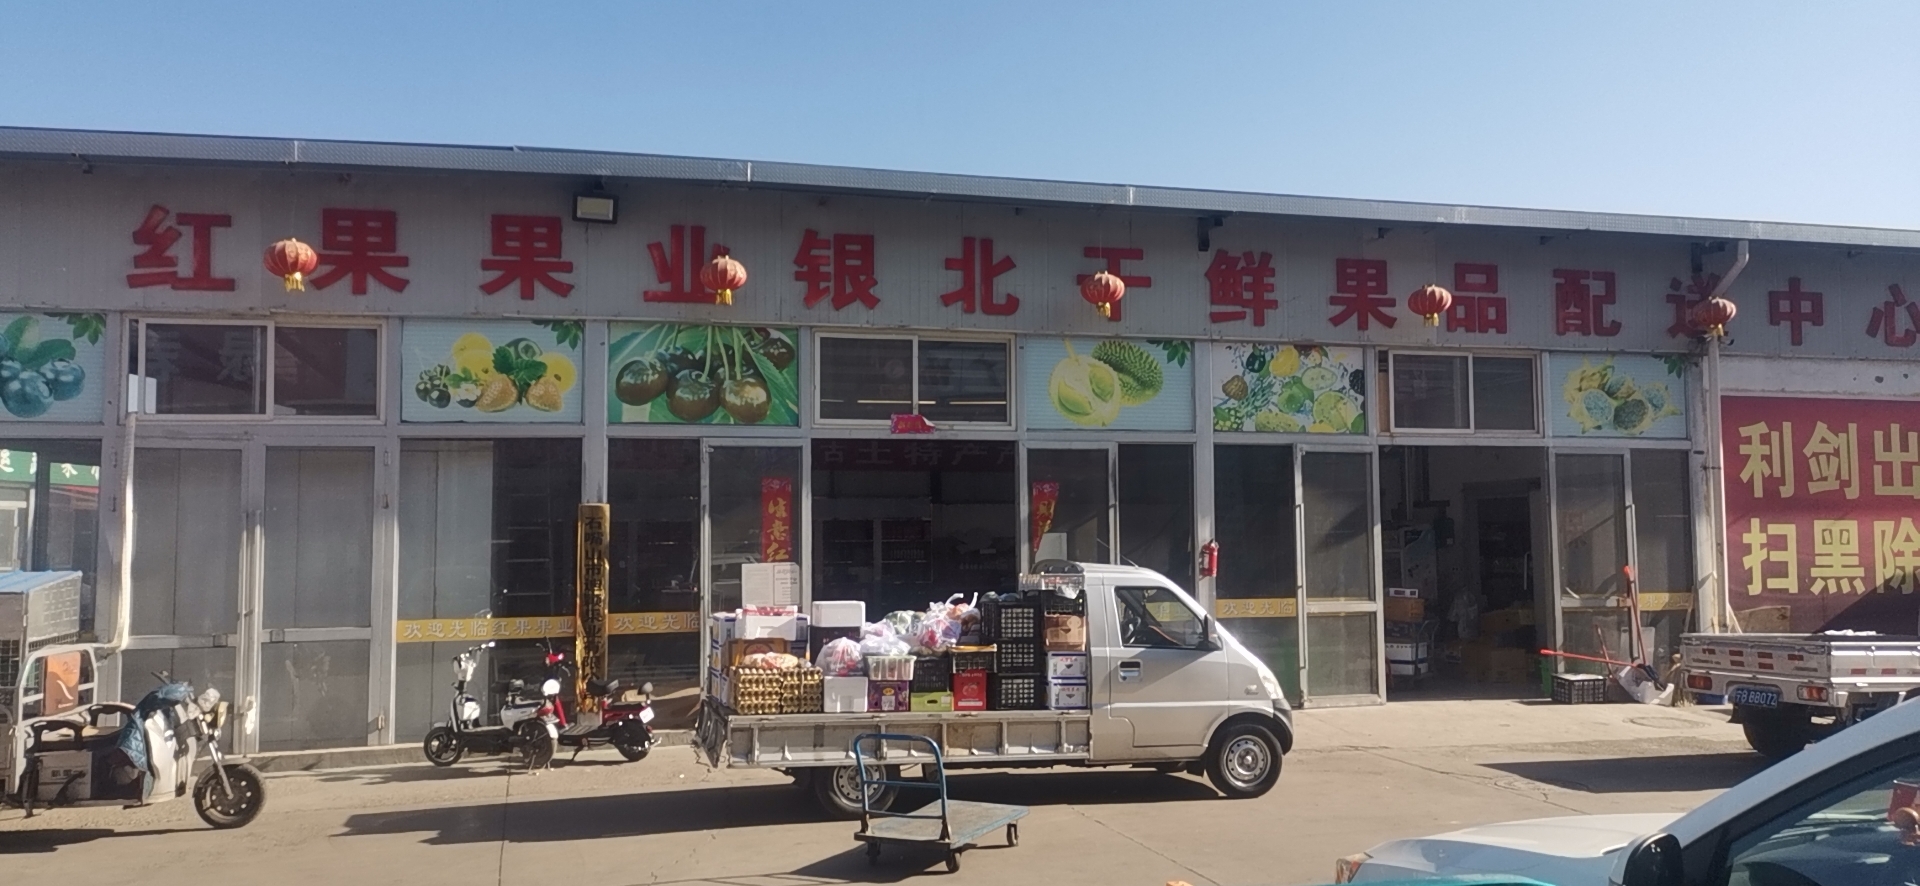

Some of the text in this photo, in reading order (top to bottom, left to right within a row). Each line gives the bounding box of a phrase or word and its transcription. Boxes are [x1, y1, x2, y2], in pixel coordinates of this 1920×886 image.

[1738, 420, 1920, 499] 利剑出
[1742, 517, 1920, 596] 扫黑除
[403, 619, 574, 639] 欢迎光临红果果业
[1222, 600, 1295, 615] 欢迎光临
